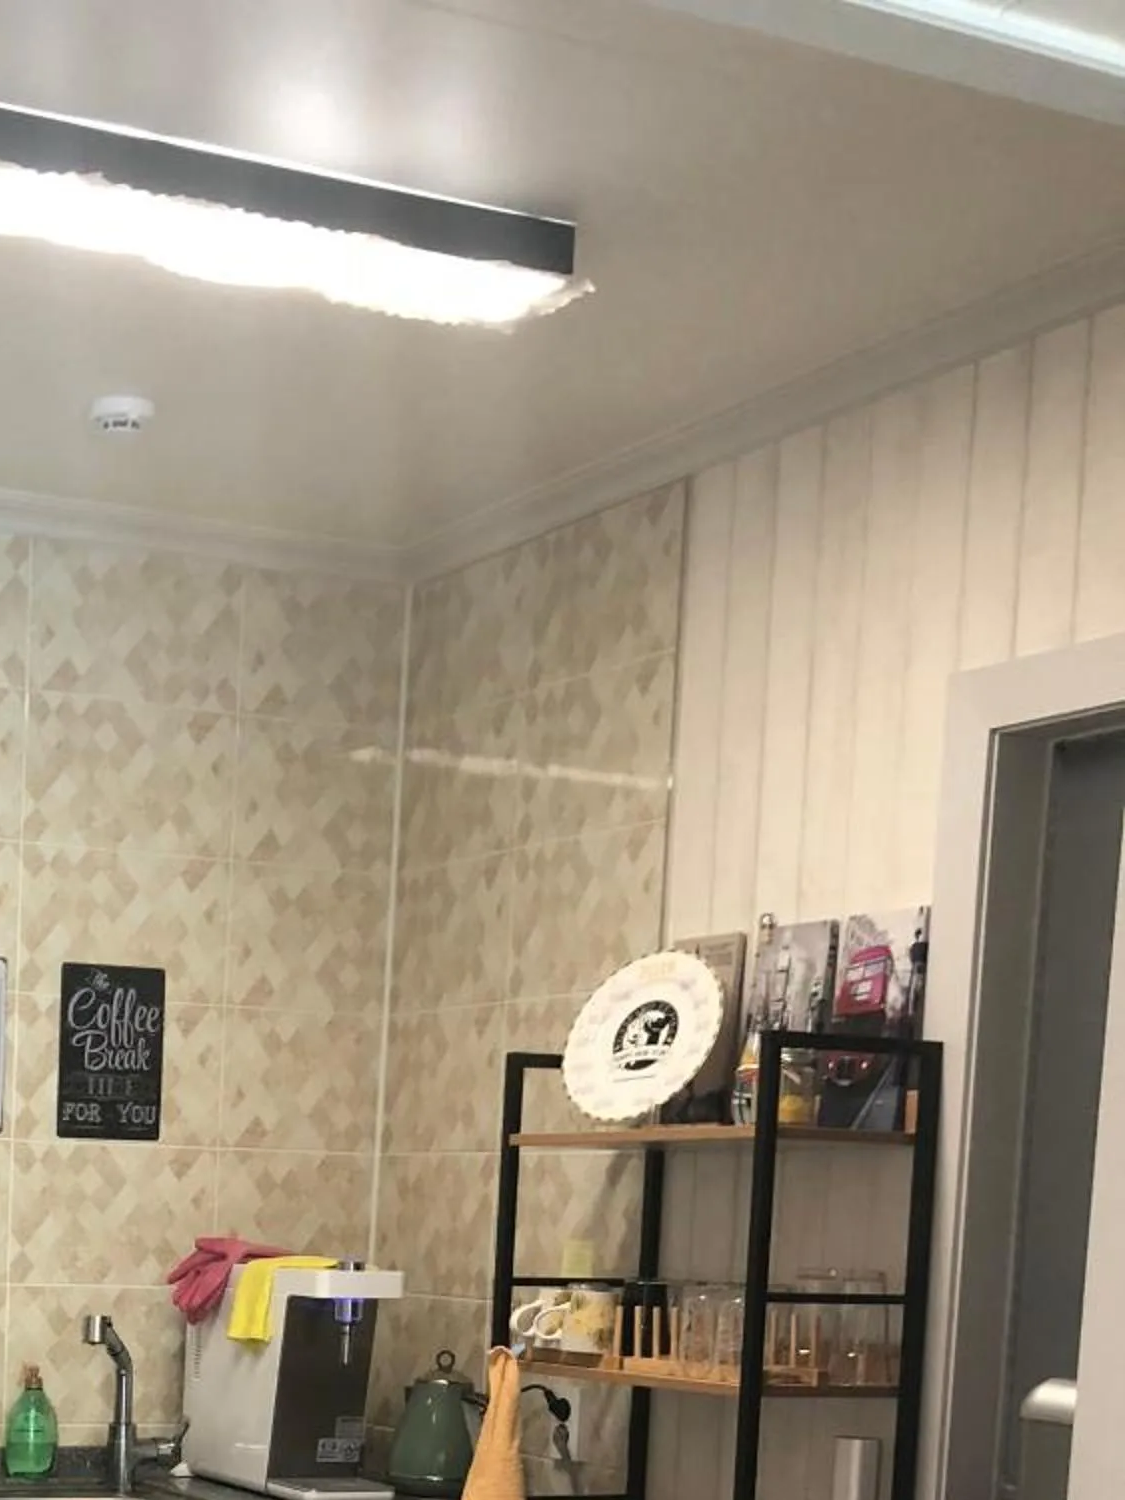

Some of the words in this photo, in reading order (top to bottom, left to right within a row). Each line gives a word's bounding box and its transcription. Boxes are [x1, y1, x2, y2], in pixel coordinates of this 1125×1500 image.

[68, 987, 161, 1049] Coffee
[72, 1029, 151, 1071] Break
[62, 1102, 102, 1123] FOR
[116, 1102, 156, 1125] YOU
